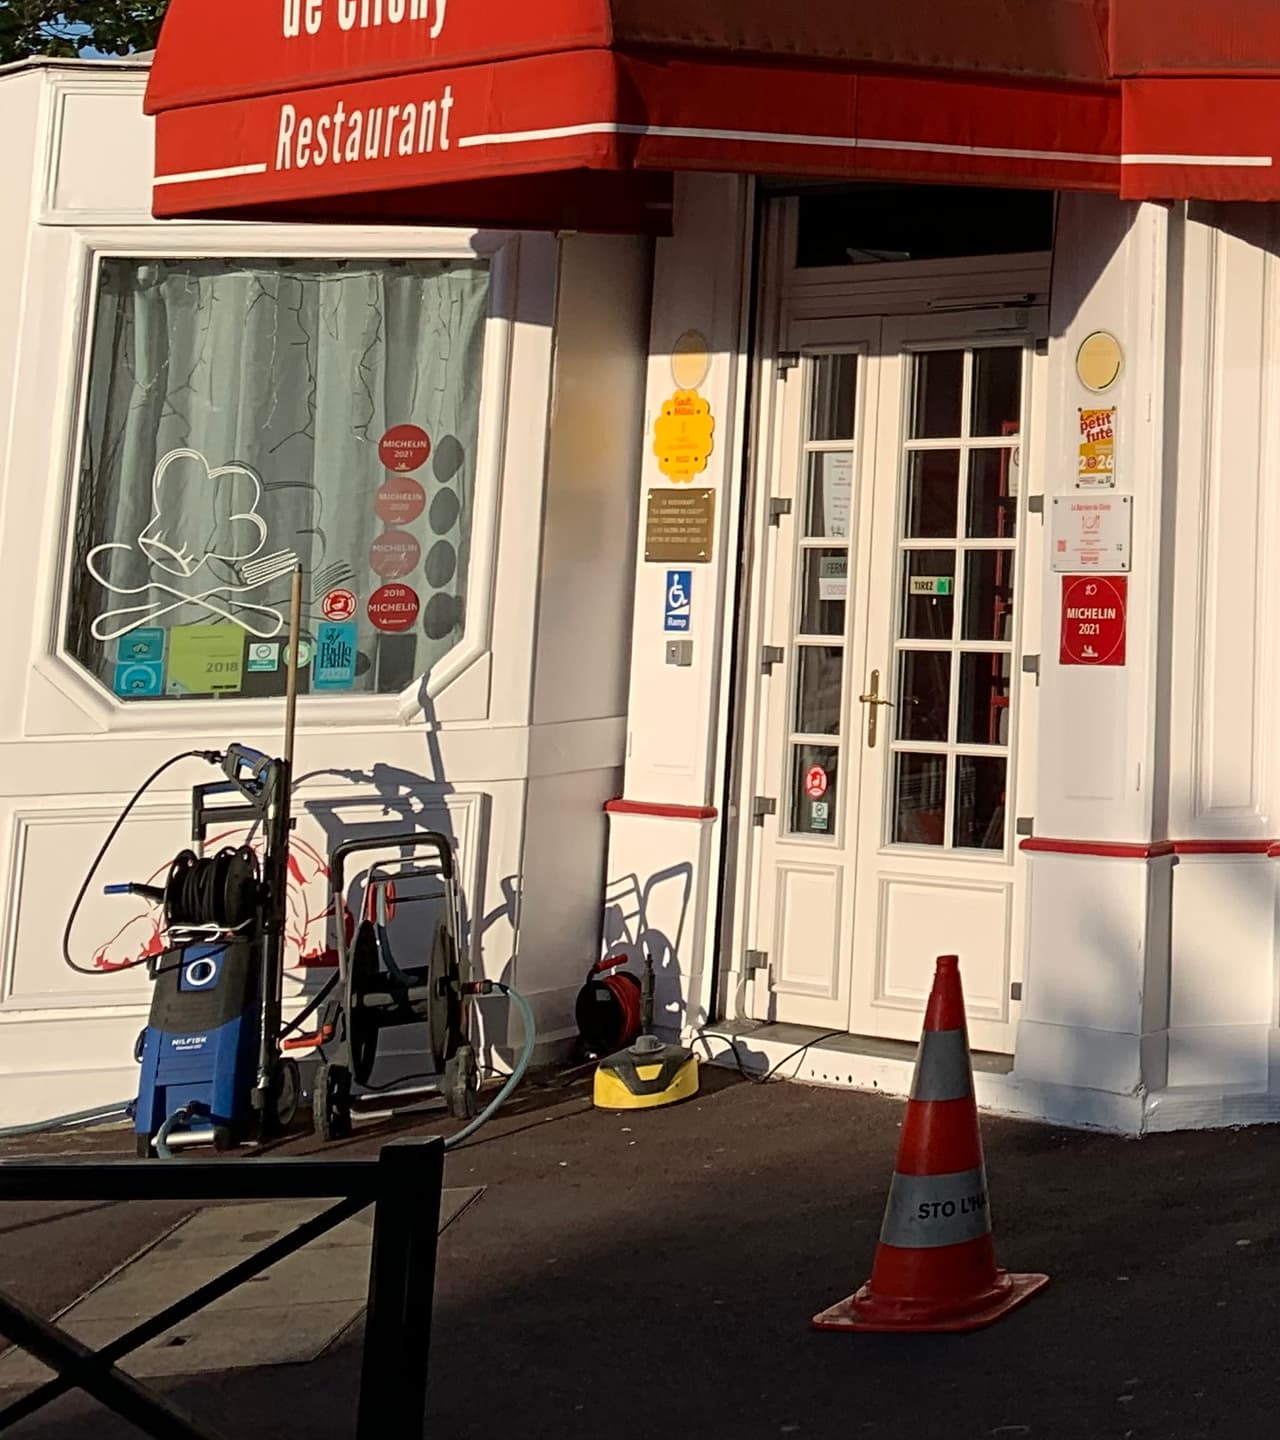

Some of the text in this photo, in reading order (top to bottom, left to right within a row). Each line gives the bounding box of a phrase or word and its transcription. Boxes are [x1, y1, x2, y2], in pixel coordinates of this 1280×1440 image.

[275, 85, 455, 171] Restaurant
[383, 440, 427, 448] MICHELIN
[378, 492, 423, 501] MICHELIN
[827, 562, 847, 574] FERM
[914, 581, 934, 590] TIREZ
[384, 589, 405, 597] 2018
[368, 603, 418, 612] MICHELIN
[1066, 608, 1116, 619] MICHELIN
[1078, 623, 1100, 635] 2021
[206, 662, 239, 673] 2018
[918, 1200, 956, 1219] STO
